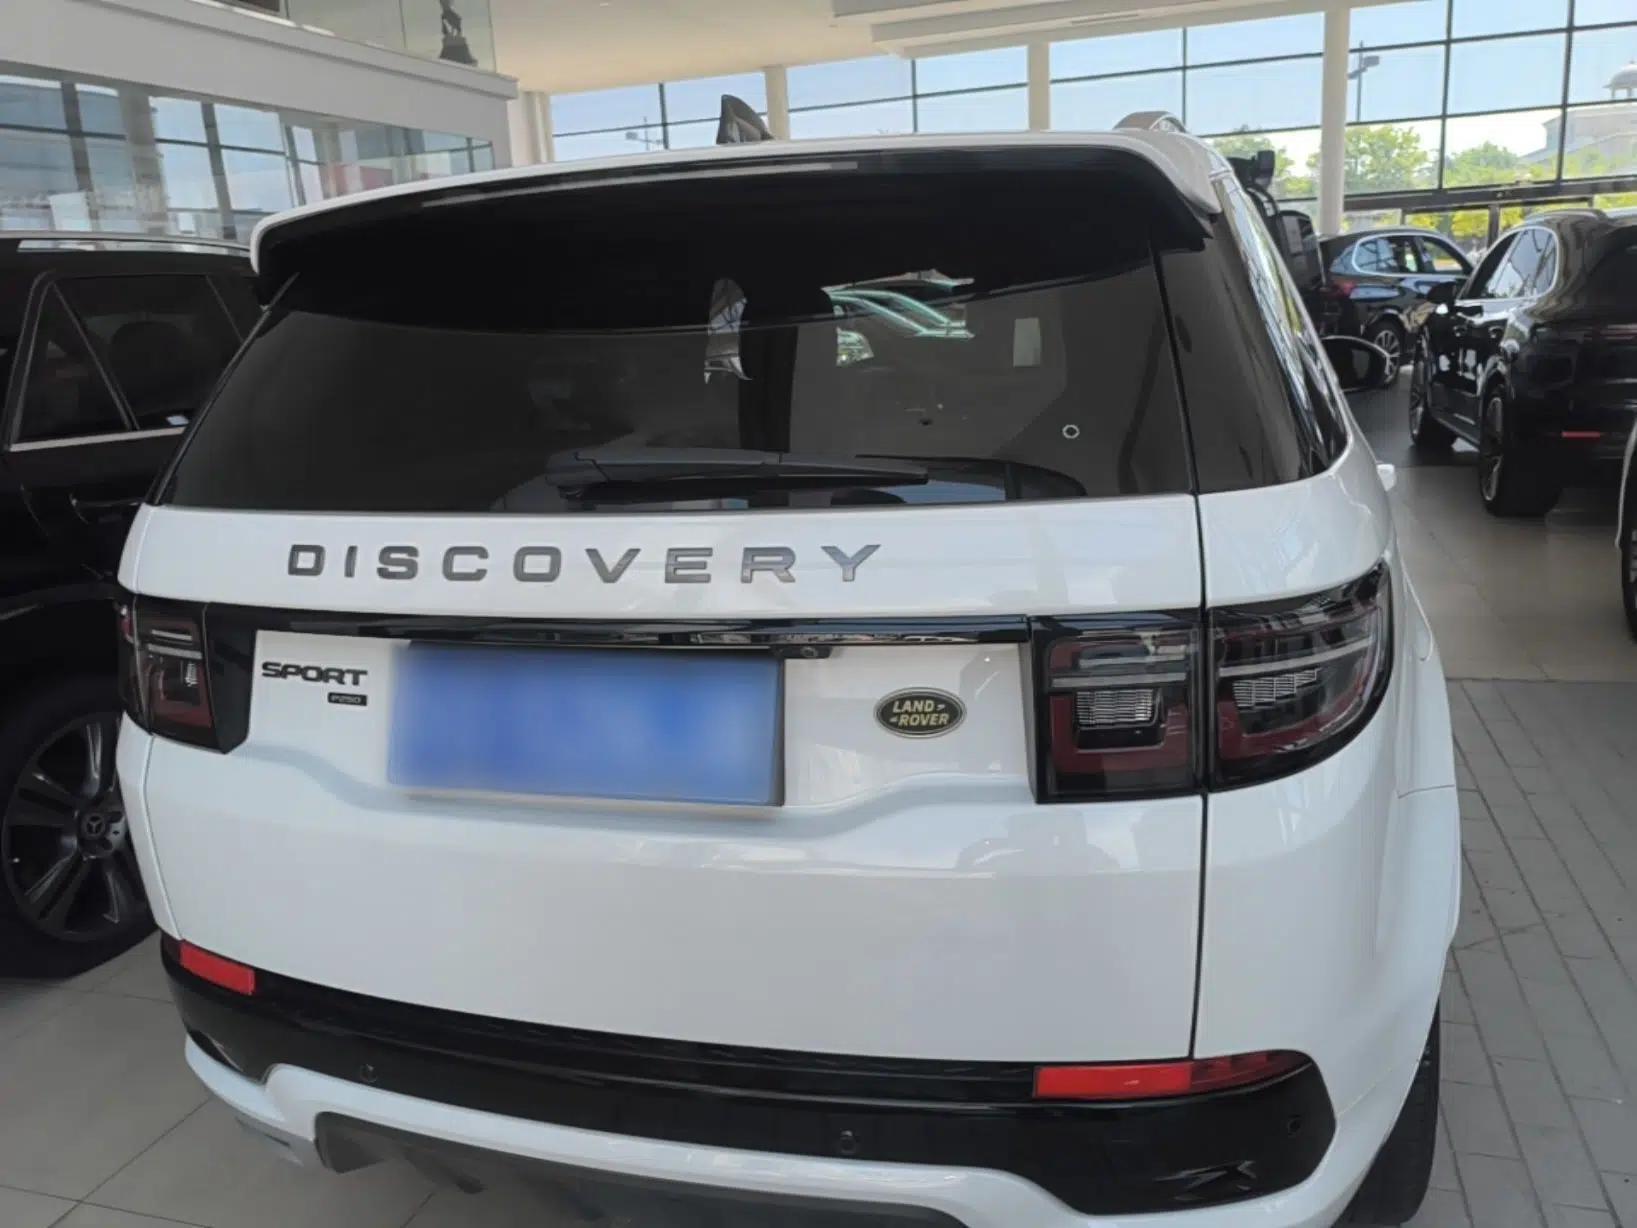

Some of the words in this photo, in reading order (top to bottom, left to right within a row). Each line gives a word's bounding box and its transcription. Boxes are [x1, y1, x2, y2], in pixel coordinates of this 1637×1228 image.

[287, 543, 881, 584] DISCOVERY
[262, 661, 368, 686] SPORT
[892, 699, 935, 713] LAND
[898, 713, 949, 726] ROVER
